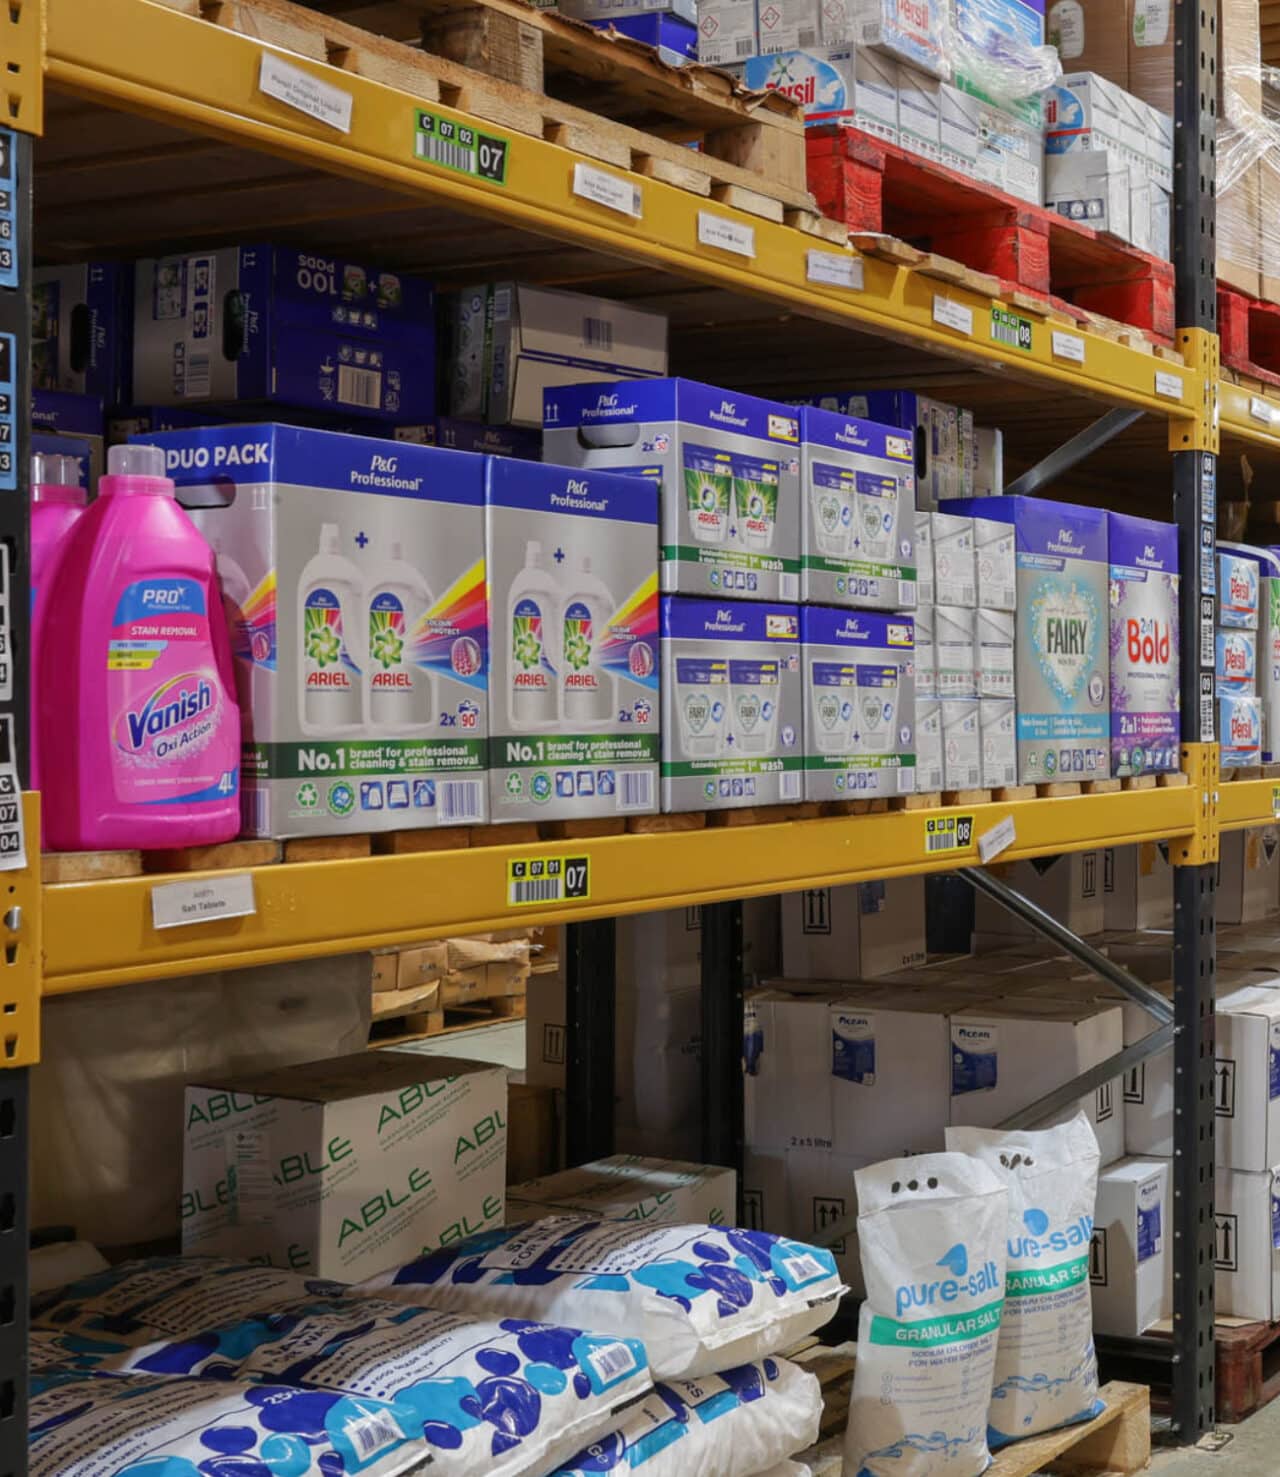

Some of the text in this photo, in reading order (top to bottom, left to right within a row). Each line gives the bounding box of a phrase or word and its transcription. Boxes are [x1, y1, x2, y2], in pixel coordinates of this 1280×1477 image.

[422, 116, 472, 144] C 07 02
[480, 144, 503, 172] 07
[297, 254, 335, 273] PODS
[297, 271, 337, 296] 100
[1020, 325, 1031, 344] 08
[598, 393, 619, 407] P&G
[720, 400, 737, 415] P&G
[581, 404, 634, 418] Professional
[709, 410, 748, 427] Professional
[166, 442, 270, 469] DUO PACK
[370, 455, 398, 473] P&G
[351, 470, 420, 491] Professional
[567, 480, 589, 494] P&G
[550, 493, 605, 511] Professional
[1058, 529, 1073, 543] P&G
[762, 559, 784, 573] wash
[882, 565, 902, 579] wash
[143, 588, 179, 605] PRO
[1230, 576, 1250, 601] Persil
[716, 609, 732, 624] P&G
[130, 625, 198, 638] STAIN REMOVAL
[1047, 617, 1088, 655] FAIRY
[1127, 618, 1170, 665] Bold
[1225, 647, 1247, 671] Persil
[307, 671, 350, 687] ARIEL
[371, 672, 413, 687] ARIEL
[514, 673, 548, 687] ARIEL
[564, 674, 598, 688] ARIEL
[128, 681, 211, 748] Vanish
[440, 712, 457, 728] 2x
[460, 711, 477, 729] 90
[618, 709, 633, 723] 2x
[635, 709, 649, 724] 90
[1231, 718, 1252, 741] Persil
[156, 721, 212, 758] Oxi Action
[576, 741, 589, 751] for
[591, 740, 642, 754] professional
[298, 748, 346, 772] No.1
[386, 747, 401, 758] for
[404, 745, 469, 760] professional
[506, 742, 545, 763] No.1
[547, 751, 584, 761] cleaning
[593, 750, 614, 759] stain
[616, 748, 651, 759] removal
[881, 755, 901, 768] wash
[350, 755, 480, 769] cleaning & stain removal
[760, 758, 785, 772] wash
[218, 772, 234, 795] 4L
[0, 779, 18, 852] C 07 04
[957, 823, 970, 841] 08
[514, 860, 559, 876] C 07 01
[566, 865, 587, 890] 07
[181, 901, 201, 914] Salt
[378, 1074, 460, 1134] ABL
[455, 1110, 506, 1165] ABL
[273, 1137, 353, 1184] BLE
[181, 1181, 228, 1218] BLE
[338, 1168, 433, 1249] ABLE
[422, 1195, 503, 1256] BLE
[1008, 1215, 1094, 1259] ure-salt
[896, 1261, 1000, 1317] pure-salt
[896, 1307, 1001, 1341] GRANULAR SALT
[908, 1352, 957, 1367] FOR WATER
